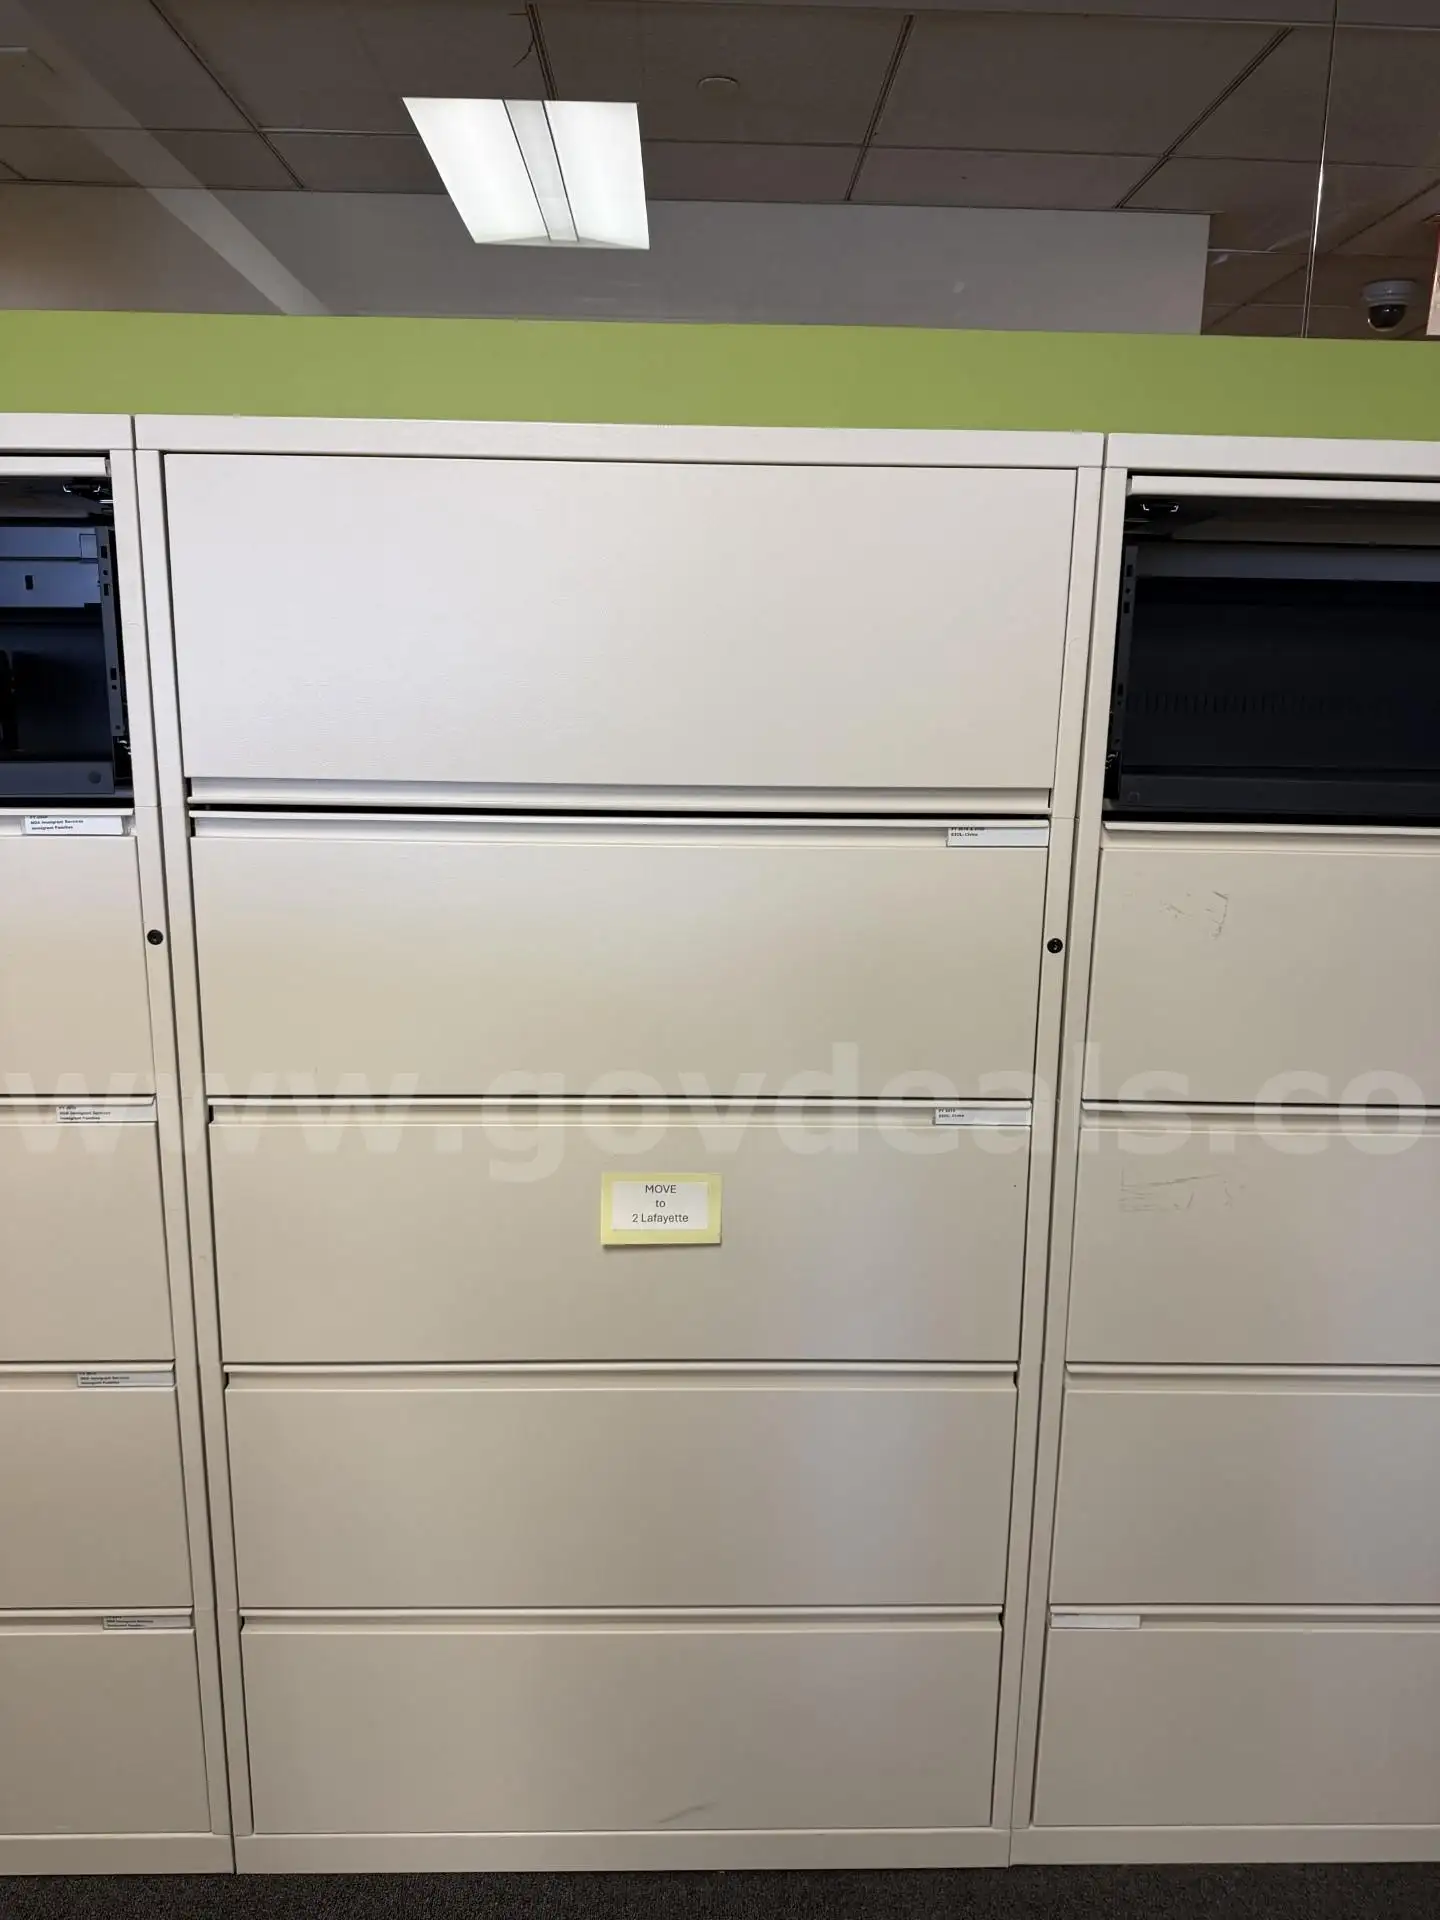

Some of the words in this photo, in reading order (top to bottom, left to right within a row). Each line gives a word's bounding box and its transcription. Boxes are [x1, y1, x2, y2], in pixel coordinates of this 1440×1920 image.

[644, 1184, 677, 1194] MOVE
[655, 1199, 666, 1208] to
[632, 1213, 639, 1223] 2
[641, 1212, 689, 1225] Lafayette
